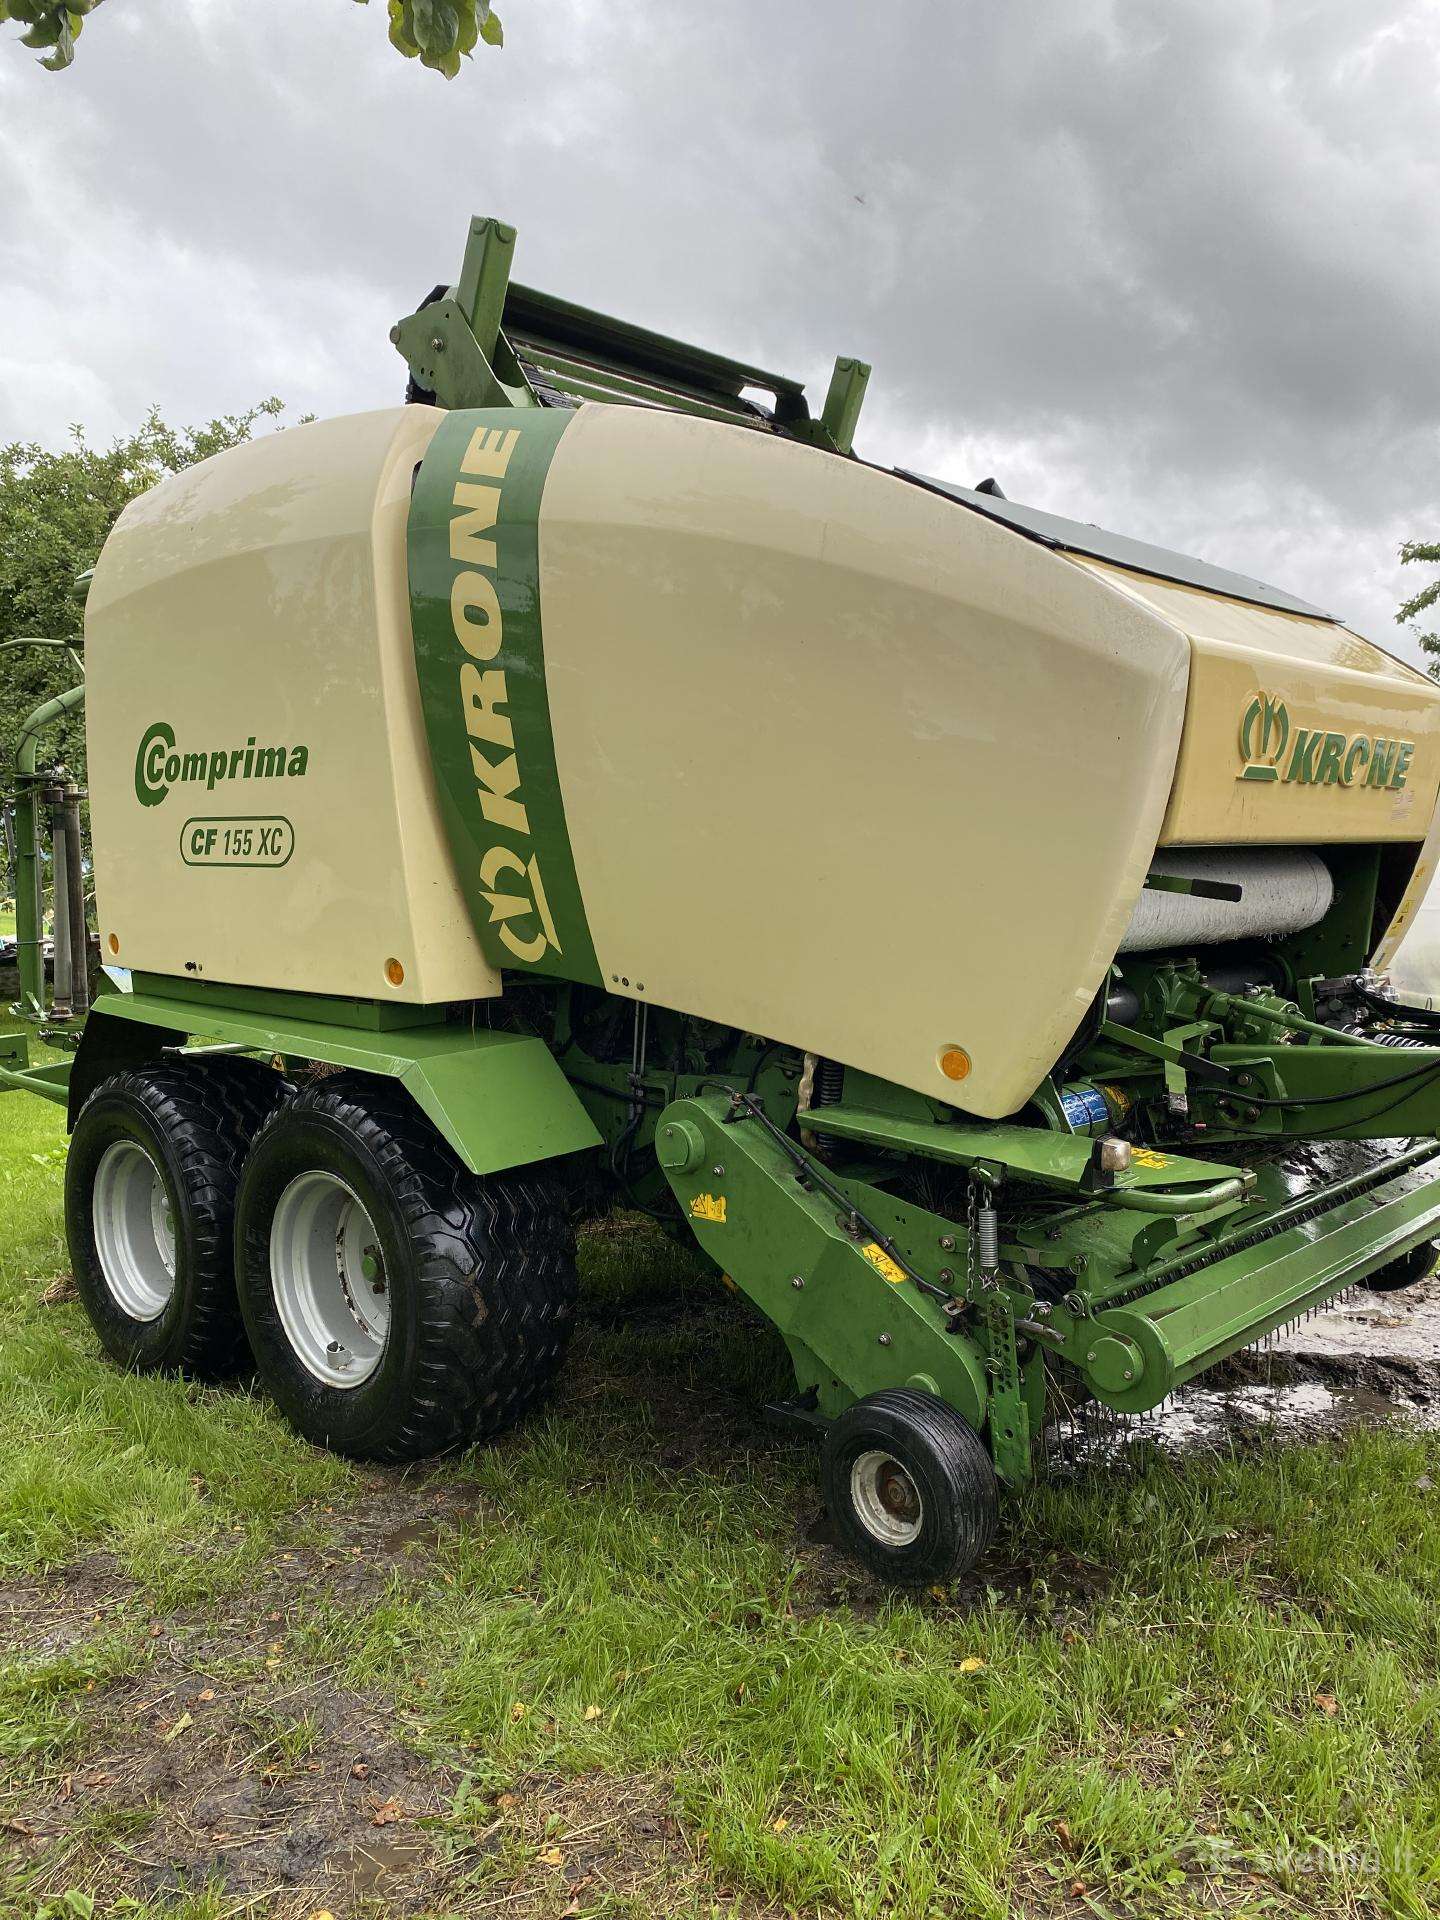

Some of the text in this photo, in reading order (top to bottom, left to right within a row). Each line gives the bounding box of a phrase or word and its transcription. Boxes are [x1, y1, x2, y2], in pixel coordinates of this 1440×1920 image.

[450, 426, 531, 835] KRONE
[134, 721, 309, 808] Comprima
[1282, 726, 1415, 789] KRONE
[190, 827, 284, 856] CF 155 XC
